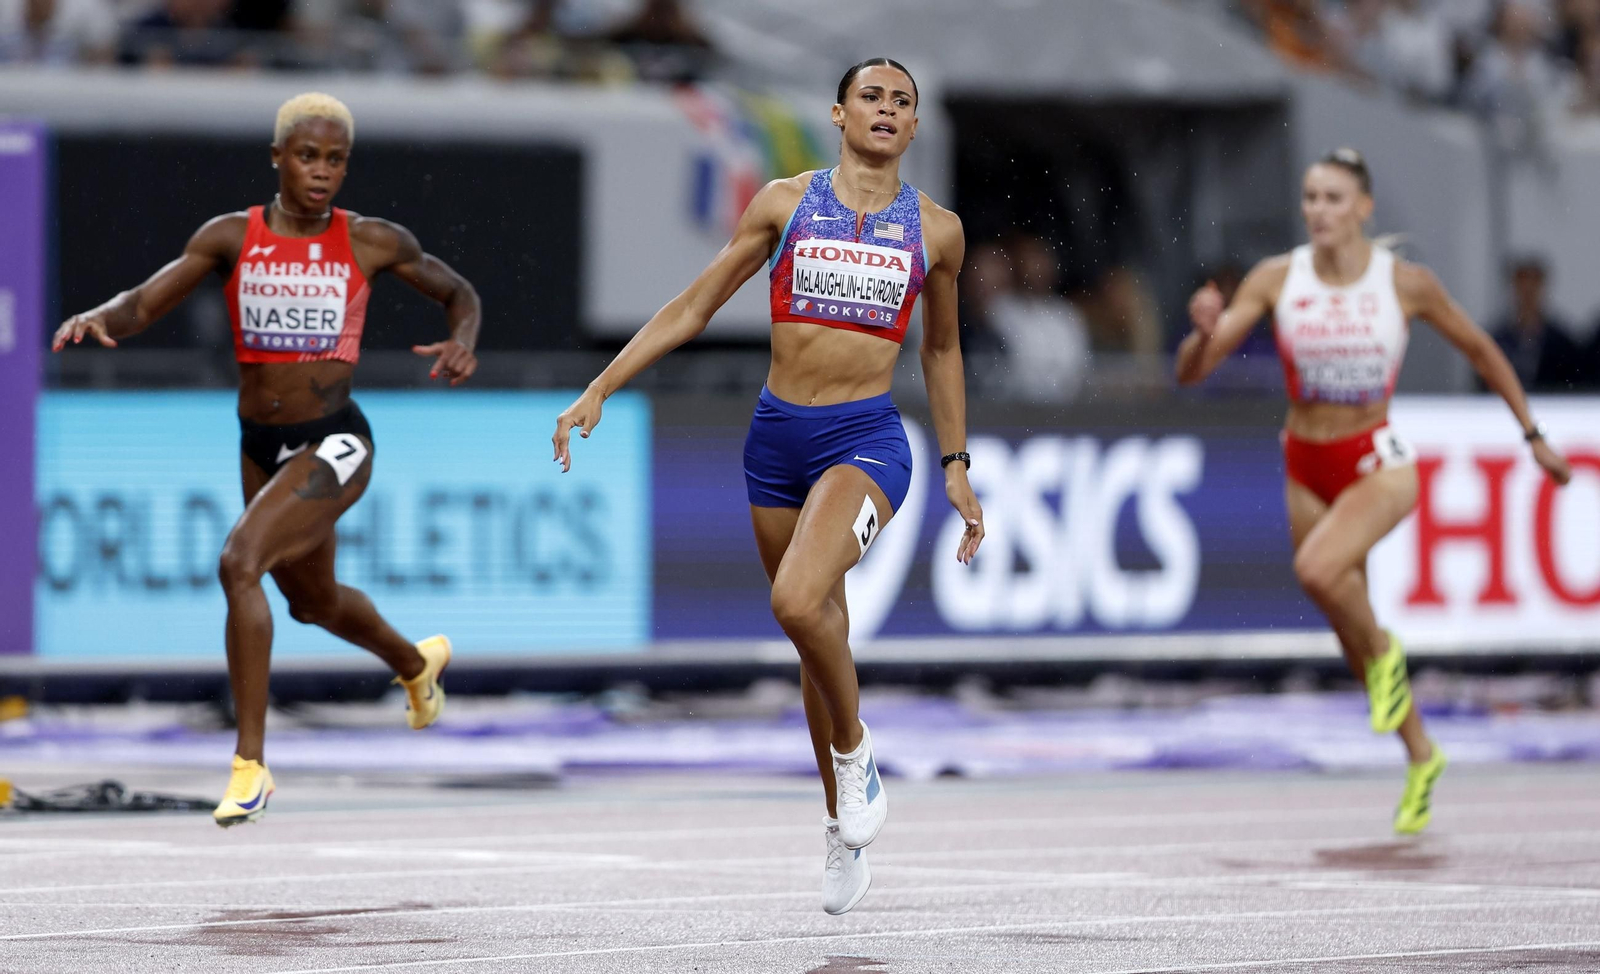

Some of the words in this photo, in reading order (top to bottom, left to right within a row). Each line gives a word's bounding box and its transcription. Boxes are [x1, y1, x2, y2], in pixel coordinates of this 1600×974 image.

[240, 261, 351, 279] BAHRAIN
[796, 246, 907, 272] HONDA
[242, 281, 342, 298] HONDA
[795, 268, 905, 306] McLAUGHLIN-LEVRONE
[245, 306, 338, 330] NASER
[334, 439, 357, 461] 7
[36, 488, 229, 593] ORLD
[861, 512, 876, 547] 5
